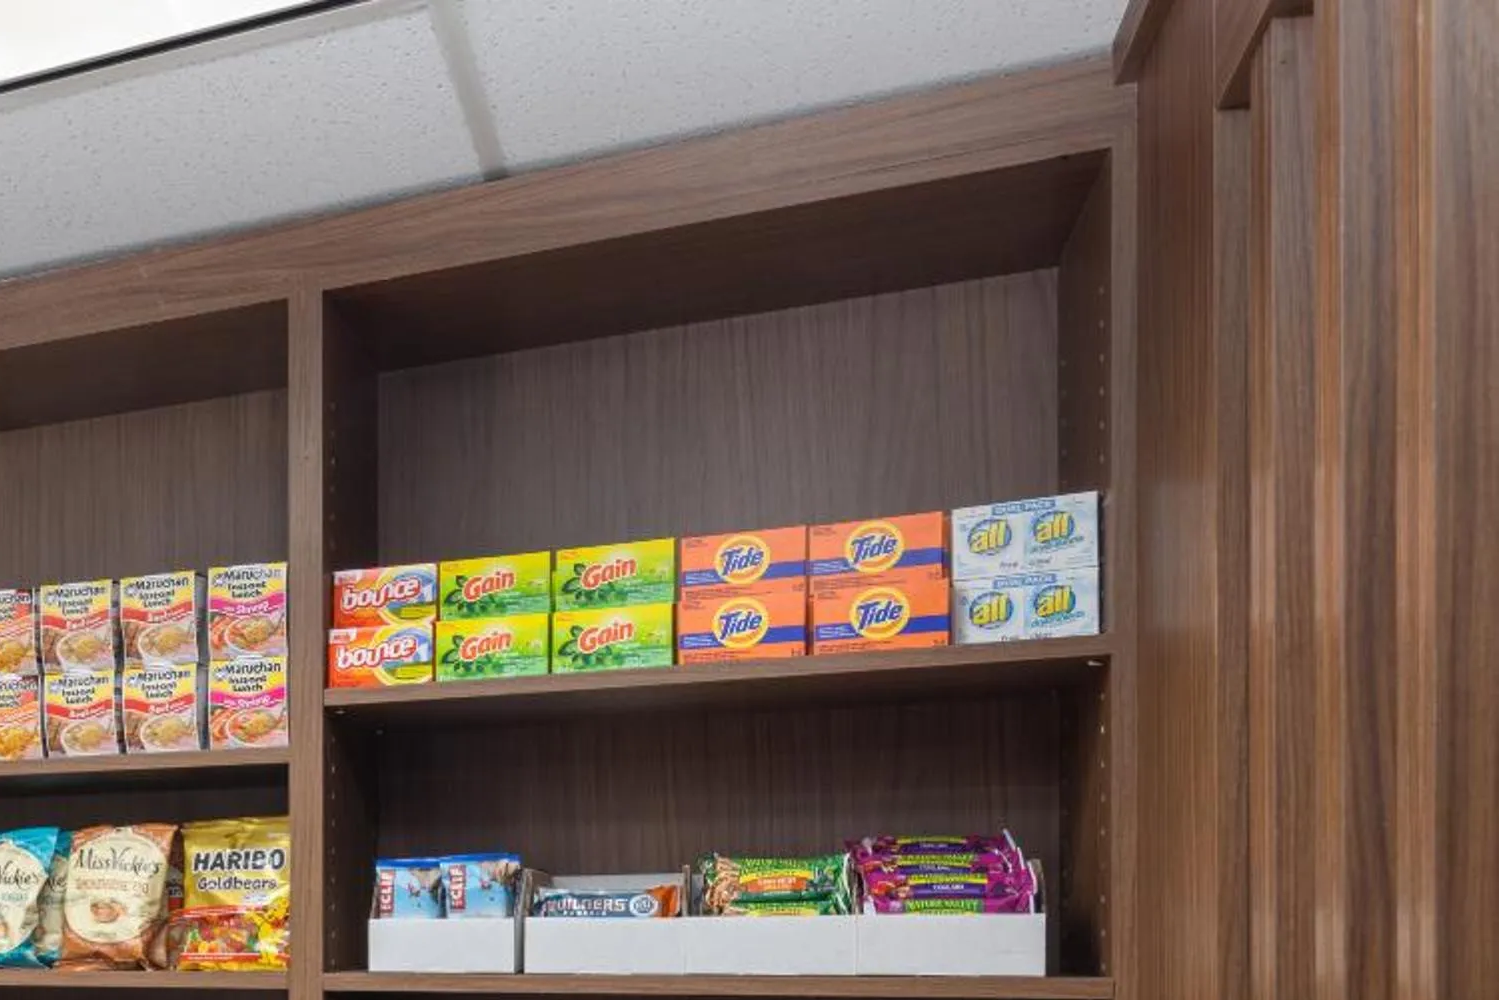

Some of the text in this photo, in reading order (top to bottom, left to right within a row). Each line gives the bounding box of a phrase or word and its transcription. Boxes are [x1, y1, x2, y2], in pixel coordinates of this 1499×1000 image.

[968, 519, 1007, 553] all
[1035, 511, 1071, 543] all
[719, 546, 764, 576] Tide
[846, 534, 898, 567] Tide
[462, 570, 515, 602] Gain
[580, 557, 637, 590] Gain
[341, 577, 420, 613] bounce
[970, 592, 1008, 626] all
[1036, 585, 1071, 617] all
[719, 611, 763, 640] Tide
[856, 600, 904, 631] Tide
[459, 632, 512, 661] Gain
[578, 620, 634, 653] Gain
[226, 662, 282, 675] Maruchan
[335, 635, 418, 671] bounce
[193, 849, 285, 872] HARIBO
[197, 876, 278, 891] Goldbears
